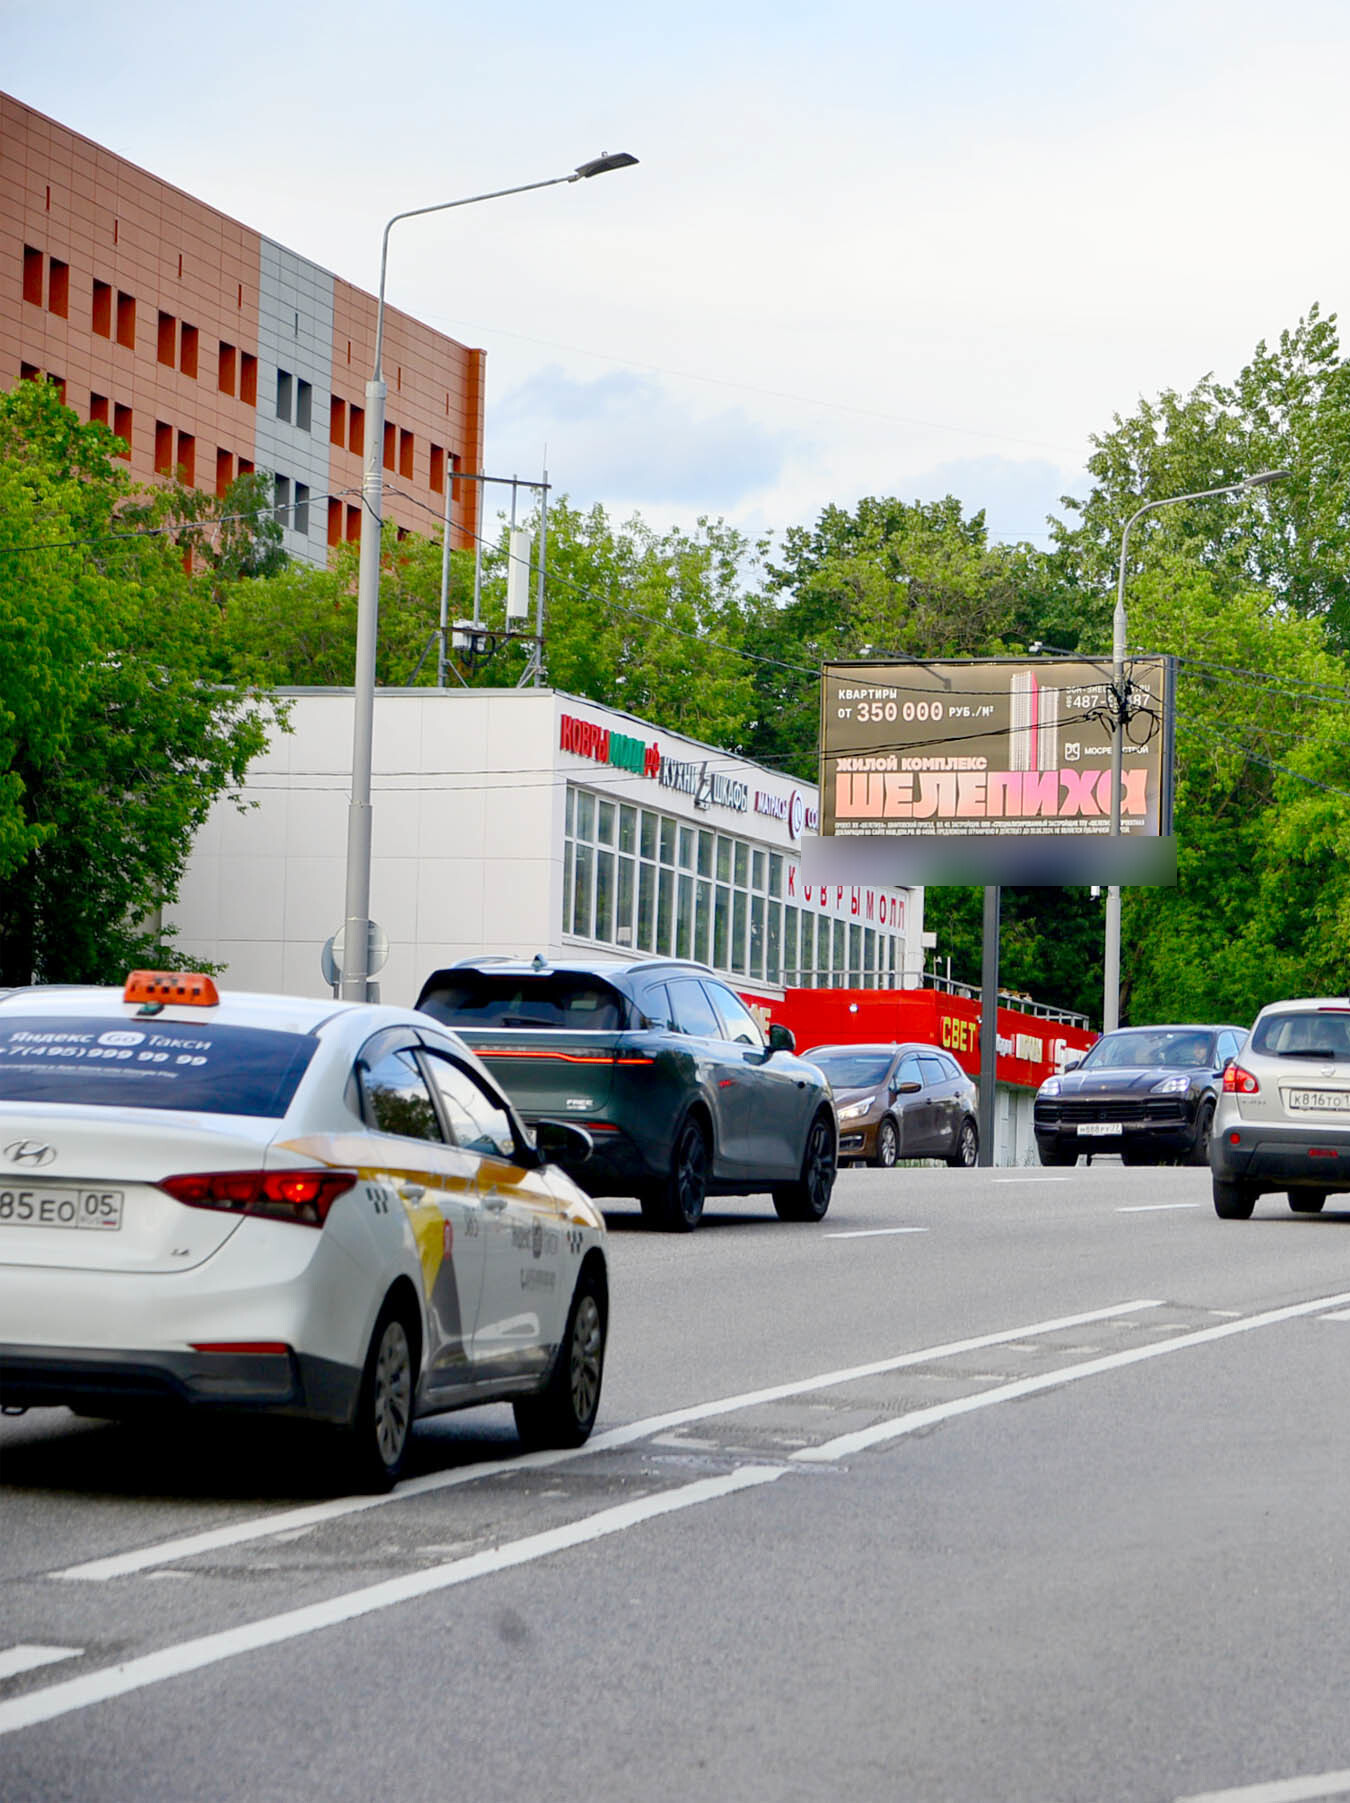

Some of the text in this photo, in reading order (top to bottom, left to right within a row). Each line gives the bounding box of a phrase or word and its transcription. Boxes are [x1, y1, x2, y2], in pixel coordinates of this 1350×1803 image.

[838, 688, 898, 700] КВАРТИРЫ
[837, 708, 852, 719] ОТ
[857, 702, 898, 722] 350
[902, 701, 943, 721] 000
[836, 755, 988, 771] ЖИЛОЙ КОМПЛЕКС
[659, 755, 698, 796] КУХНИ
[711, 773, 748, 813] ШКАФЫ
[8, 1031, 95, 1044] Яндекс
[149, 1034, 212, 1050] Такси
[942, 1015, 976, 1053] СВЕТ
[138, 1051, 170, 1063] 99
[176, 1054, 208, 1066] 99
